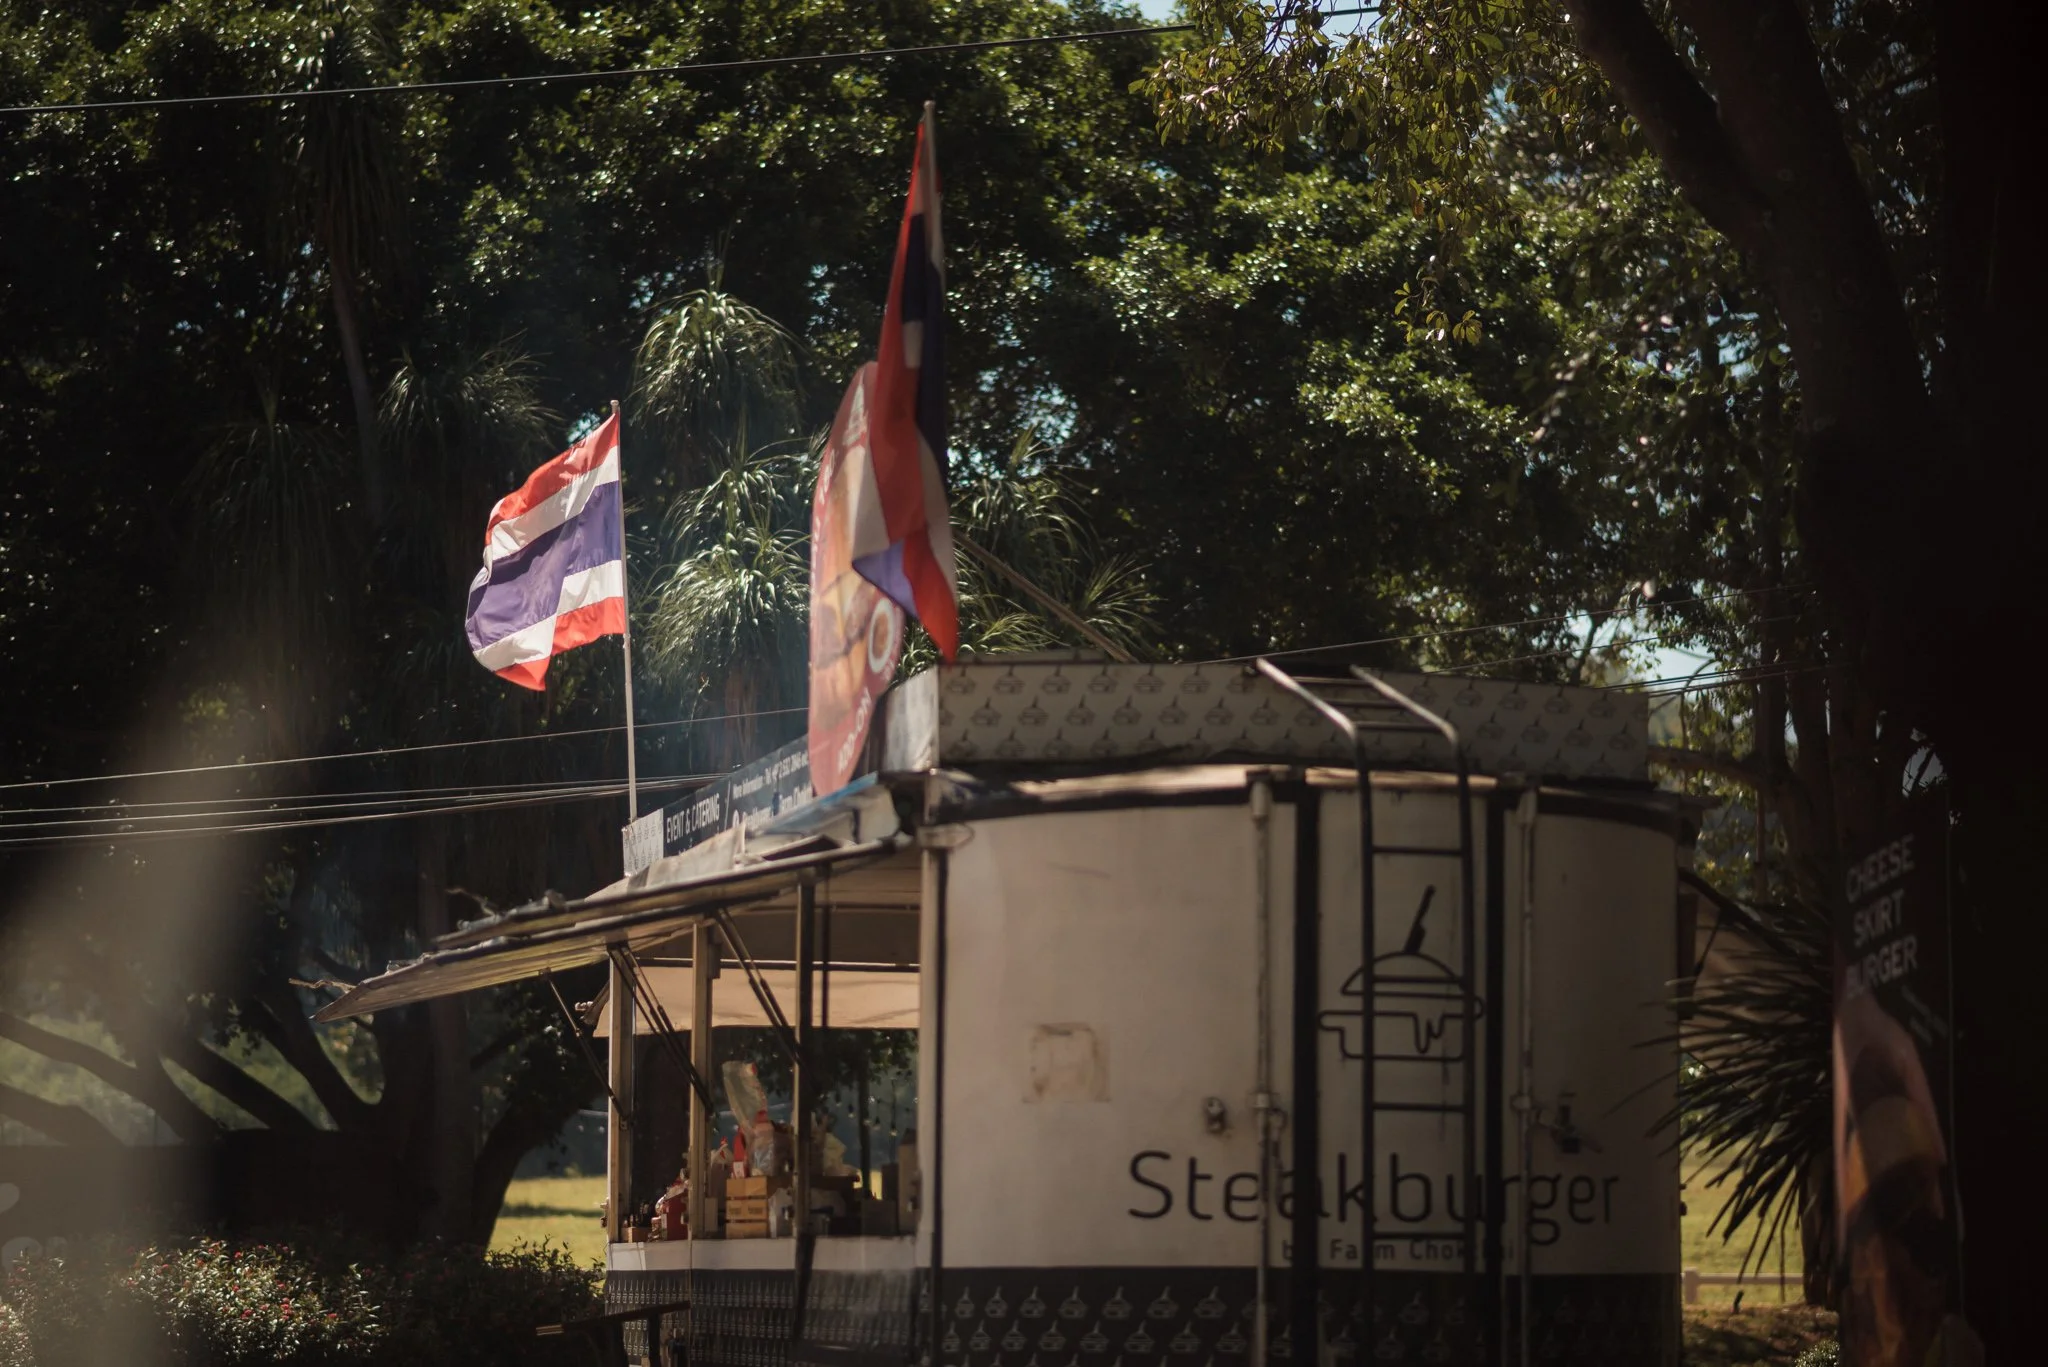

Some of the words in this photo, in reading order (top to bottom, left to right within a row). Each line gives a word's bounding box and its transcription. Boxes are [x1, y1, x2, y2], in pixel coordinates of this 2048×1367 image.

[666, 810, 685, 844] EVENT
[685, 808, 691, 835] &
[691, 792, 720, 832] CATERING
[1846, 832, 1916, 904] CHEESE
[1846, 935, 1918, 1001] BURGER
[1128, 1150, 1620, 1247] Steakburger
[1329, 1238, 1395, 1261] Fam
